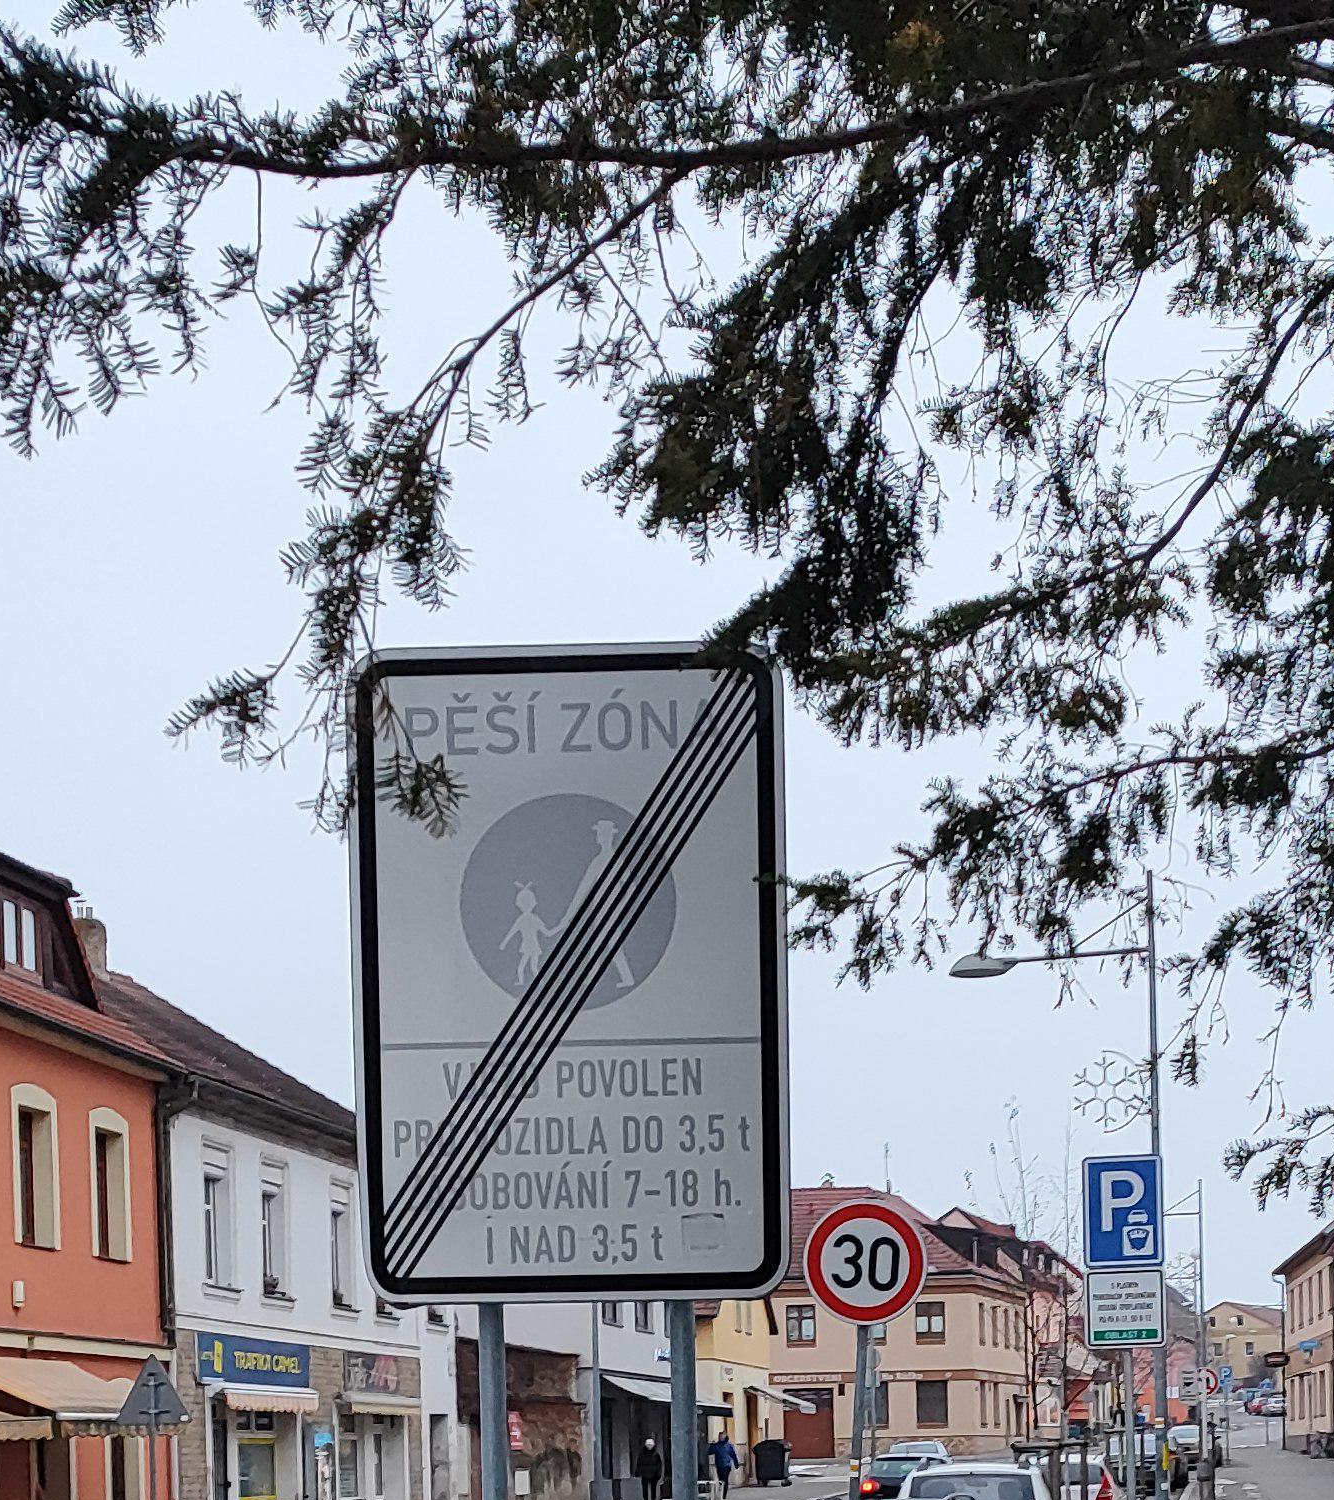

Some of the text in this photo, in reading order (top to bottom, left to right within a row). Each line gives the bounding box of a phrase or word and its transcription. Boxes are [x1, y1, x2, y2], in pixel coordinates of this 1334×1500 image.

[404, 690, 542, 755] PĚŠÍ
[556, 1058, 703, 1099] POVOLEN
[622, 1115, 663, 1154] DO
[679, 1113, 725, 1155] 3,5
[738, 1115, 751, 1152] t
[624, 1169, 699, 1209] 7-18
[714, 1168, 742, 1207] h.
[1100, 1170, 1145, 1232] P
[510, 1225, 576, 1265] NAD
[592, 1223, 638, 1266] 3,5
[651, 1225, 664, 1261] t
[831, 1233, 901, 1292] 30
